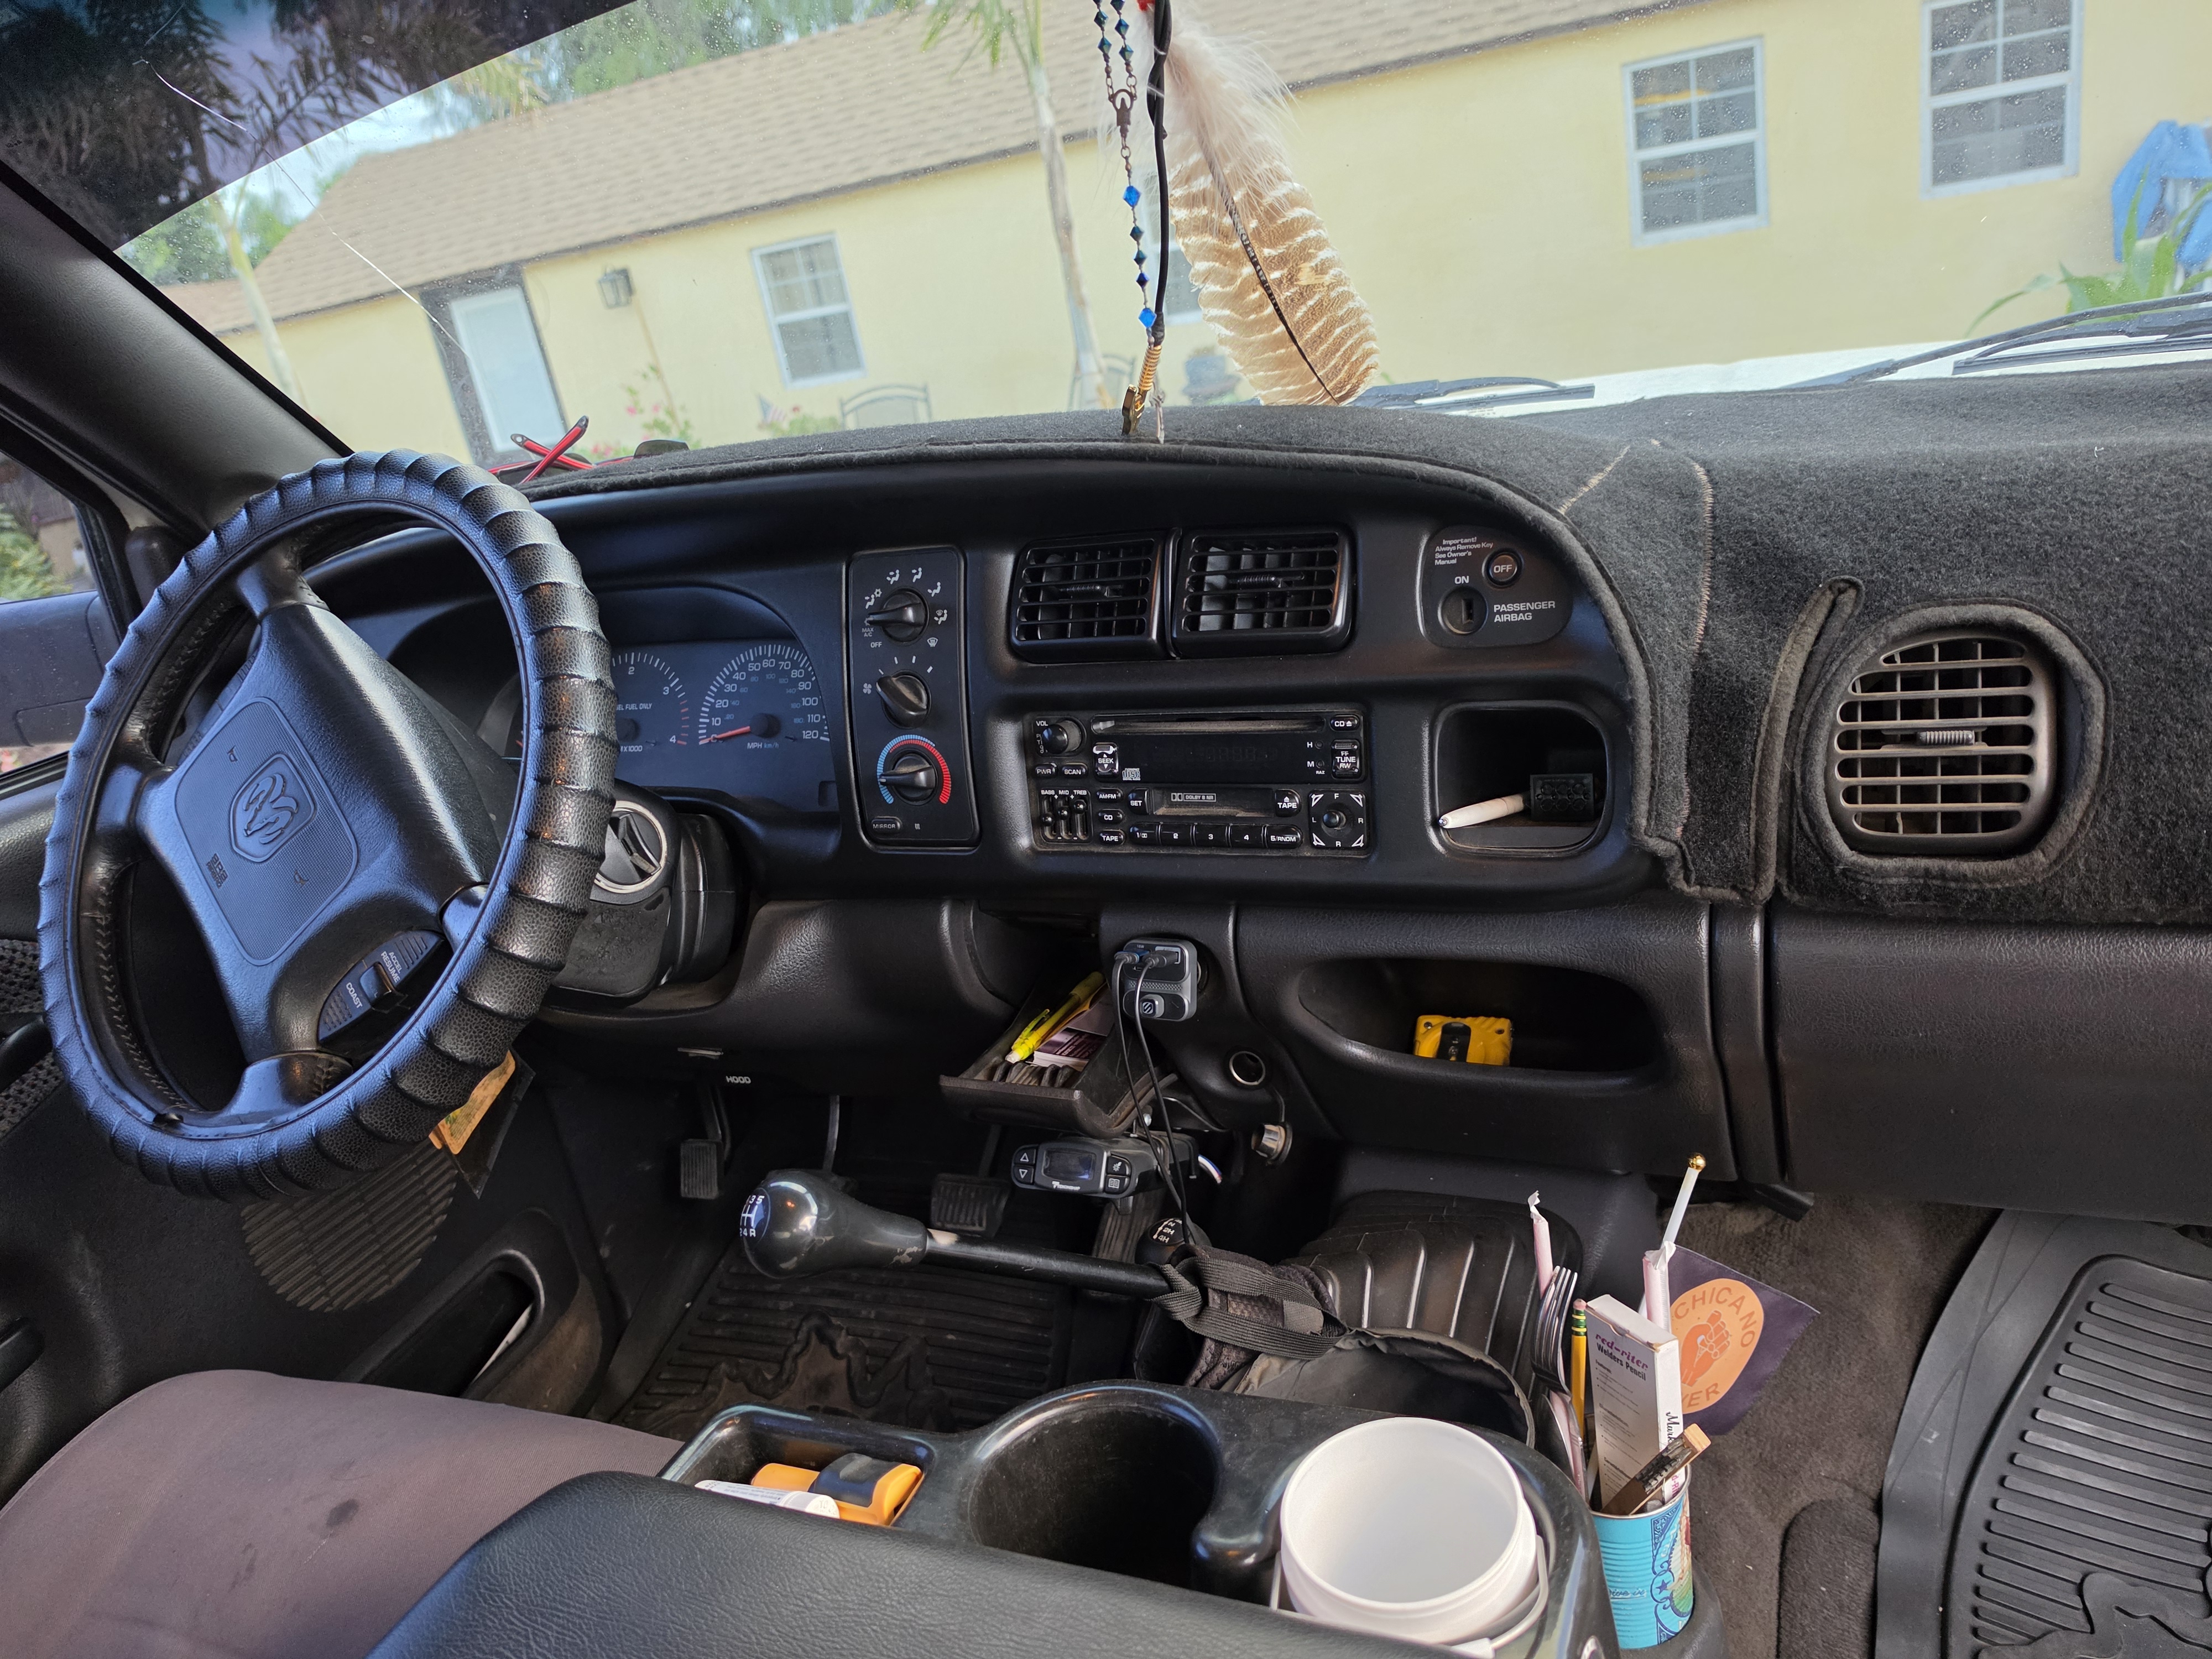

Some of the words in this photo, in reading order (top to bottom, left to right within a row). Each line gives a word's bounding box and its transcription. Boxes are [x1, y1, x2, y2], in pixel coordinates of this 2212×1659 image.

[1442, 536, 1477, 546] Important!
[1494, 564, 1512, 573] OFF
[1454, 576, 1469, 584] ON
[1494, 601, 1556, 612] PASSENGER
[1494, 613, 1532, 622] AIRBAG
[748, 662, 760, 671] 50
[763, 659, 775, 667] 60
[779, 661, 791, 670] 70
[628, 666, 635, 675] 2
[791, 669, 804, 677] 80
[733, 672, 746, 680] 40
[724, 684, 737, 692] 30
[798, 681, 811, 690] 90
[663, 686, 669, 695] 3
[716, 699, 728, 708] 20
[802, 697, 818, 706] 100
[712, 717, 721, 726] 10
[807, 714, 821, 723] 110
[802, 730, 818, 739] 120
[381, 951, 400, 983] RESUME
[389, 952, 402, 974] ACCEL
[346, 982, 363, 1008] COAST
[726, 1075, 751, 1084] HOOD
[749, 1195, 756, 1204] 3
[756, 1195, 765, 1204] 5
[743, 1228, 748, 1237] 4
[749, 1228, 756, 1237] R
[1158, 1235, 1170, 1243] 4H
[1674, 1287, 1757, 1348] CHICANO
[1595, 1334, 1648, 1369] red-riter
[1597, 1342, 1623, 1367] Welders
[1626, 1361, 1646, 1381] Pencil
